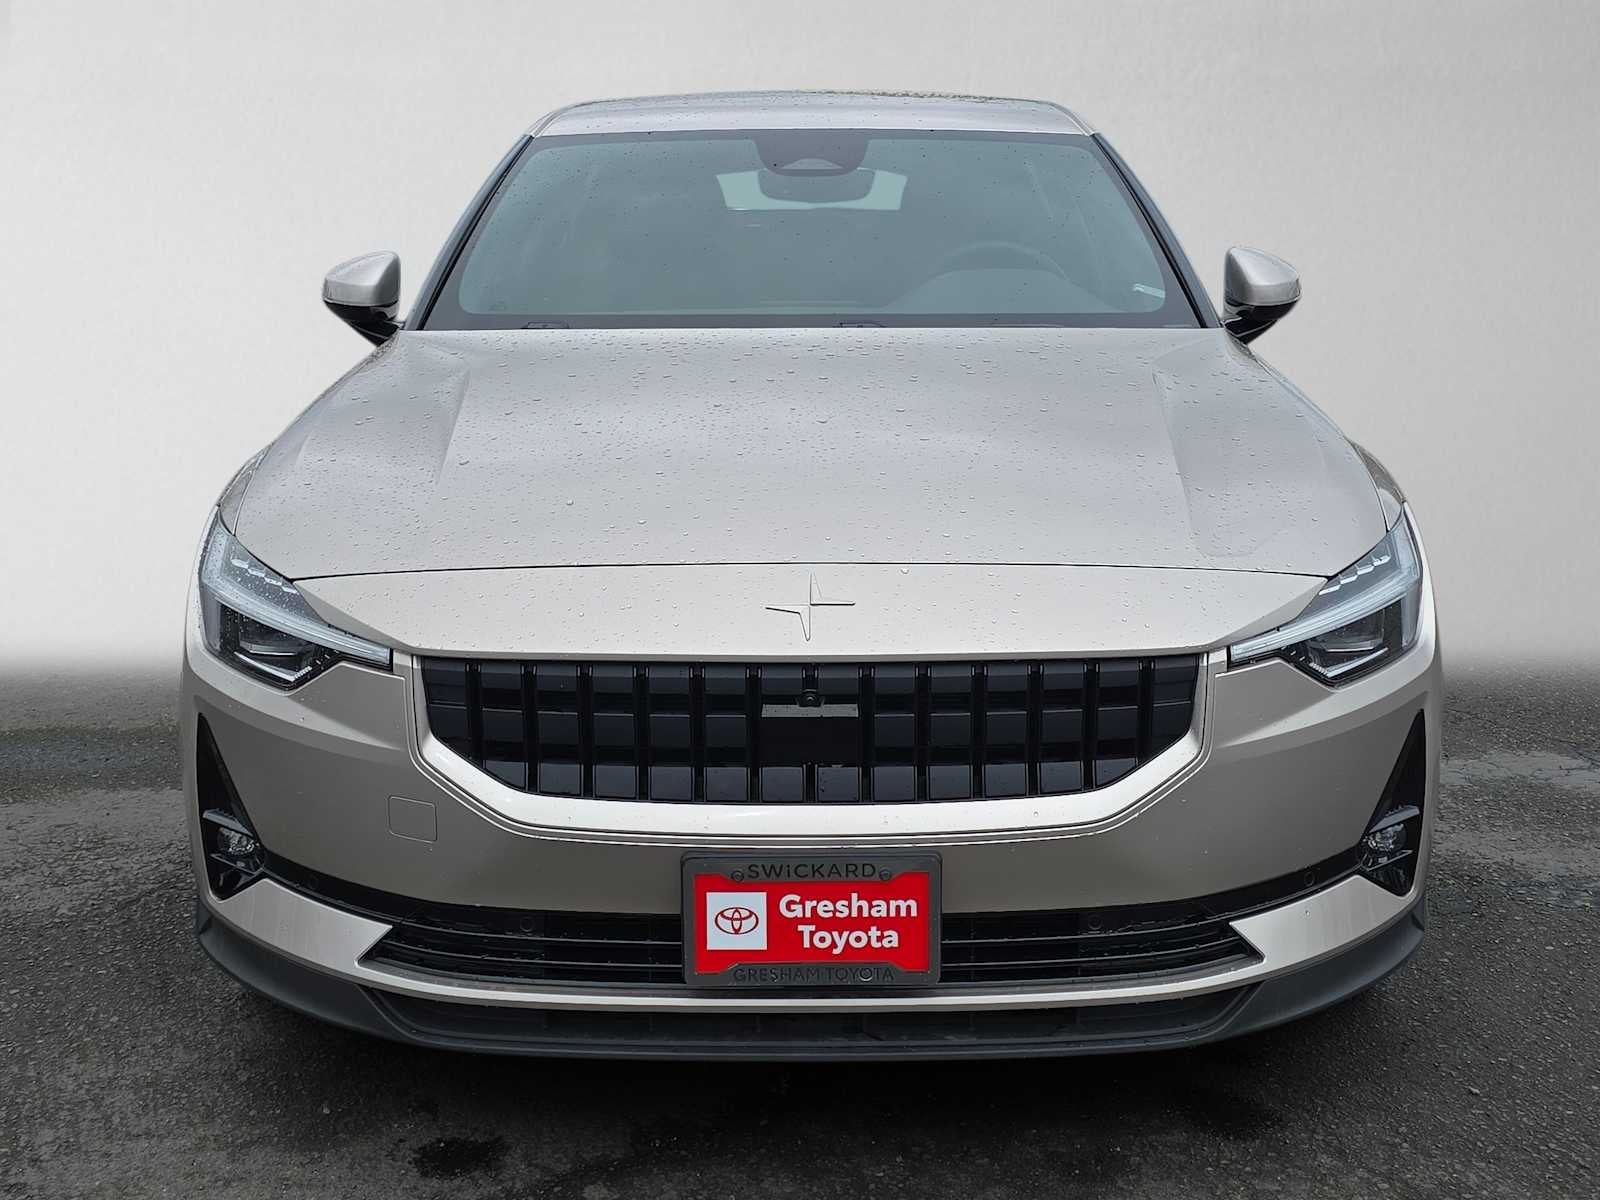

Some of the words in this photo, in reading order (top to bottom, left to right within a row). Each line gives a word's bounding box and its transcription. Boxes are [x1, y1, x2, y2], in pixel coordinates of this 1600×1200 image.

[779, 893, 918, 918] Gresham
[797, 925, 899, 954] Toyota
[733, 967, 820, 982] GRESHAM
[827, 966, 895, 982] TOYOTA
